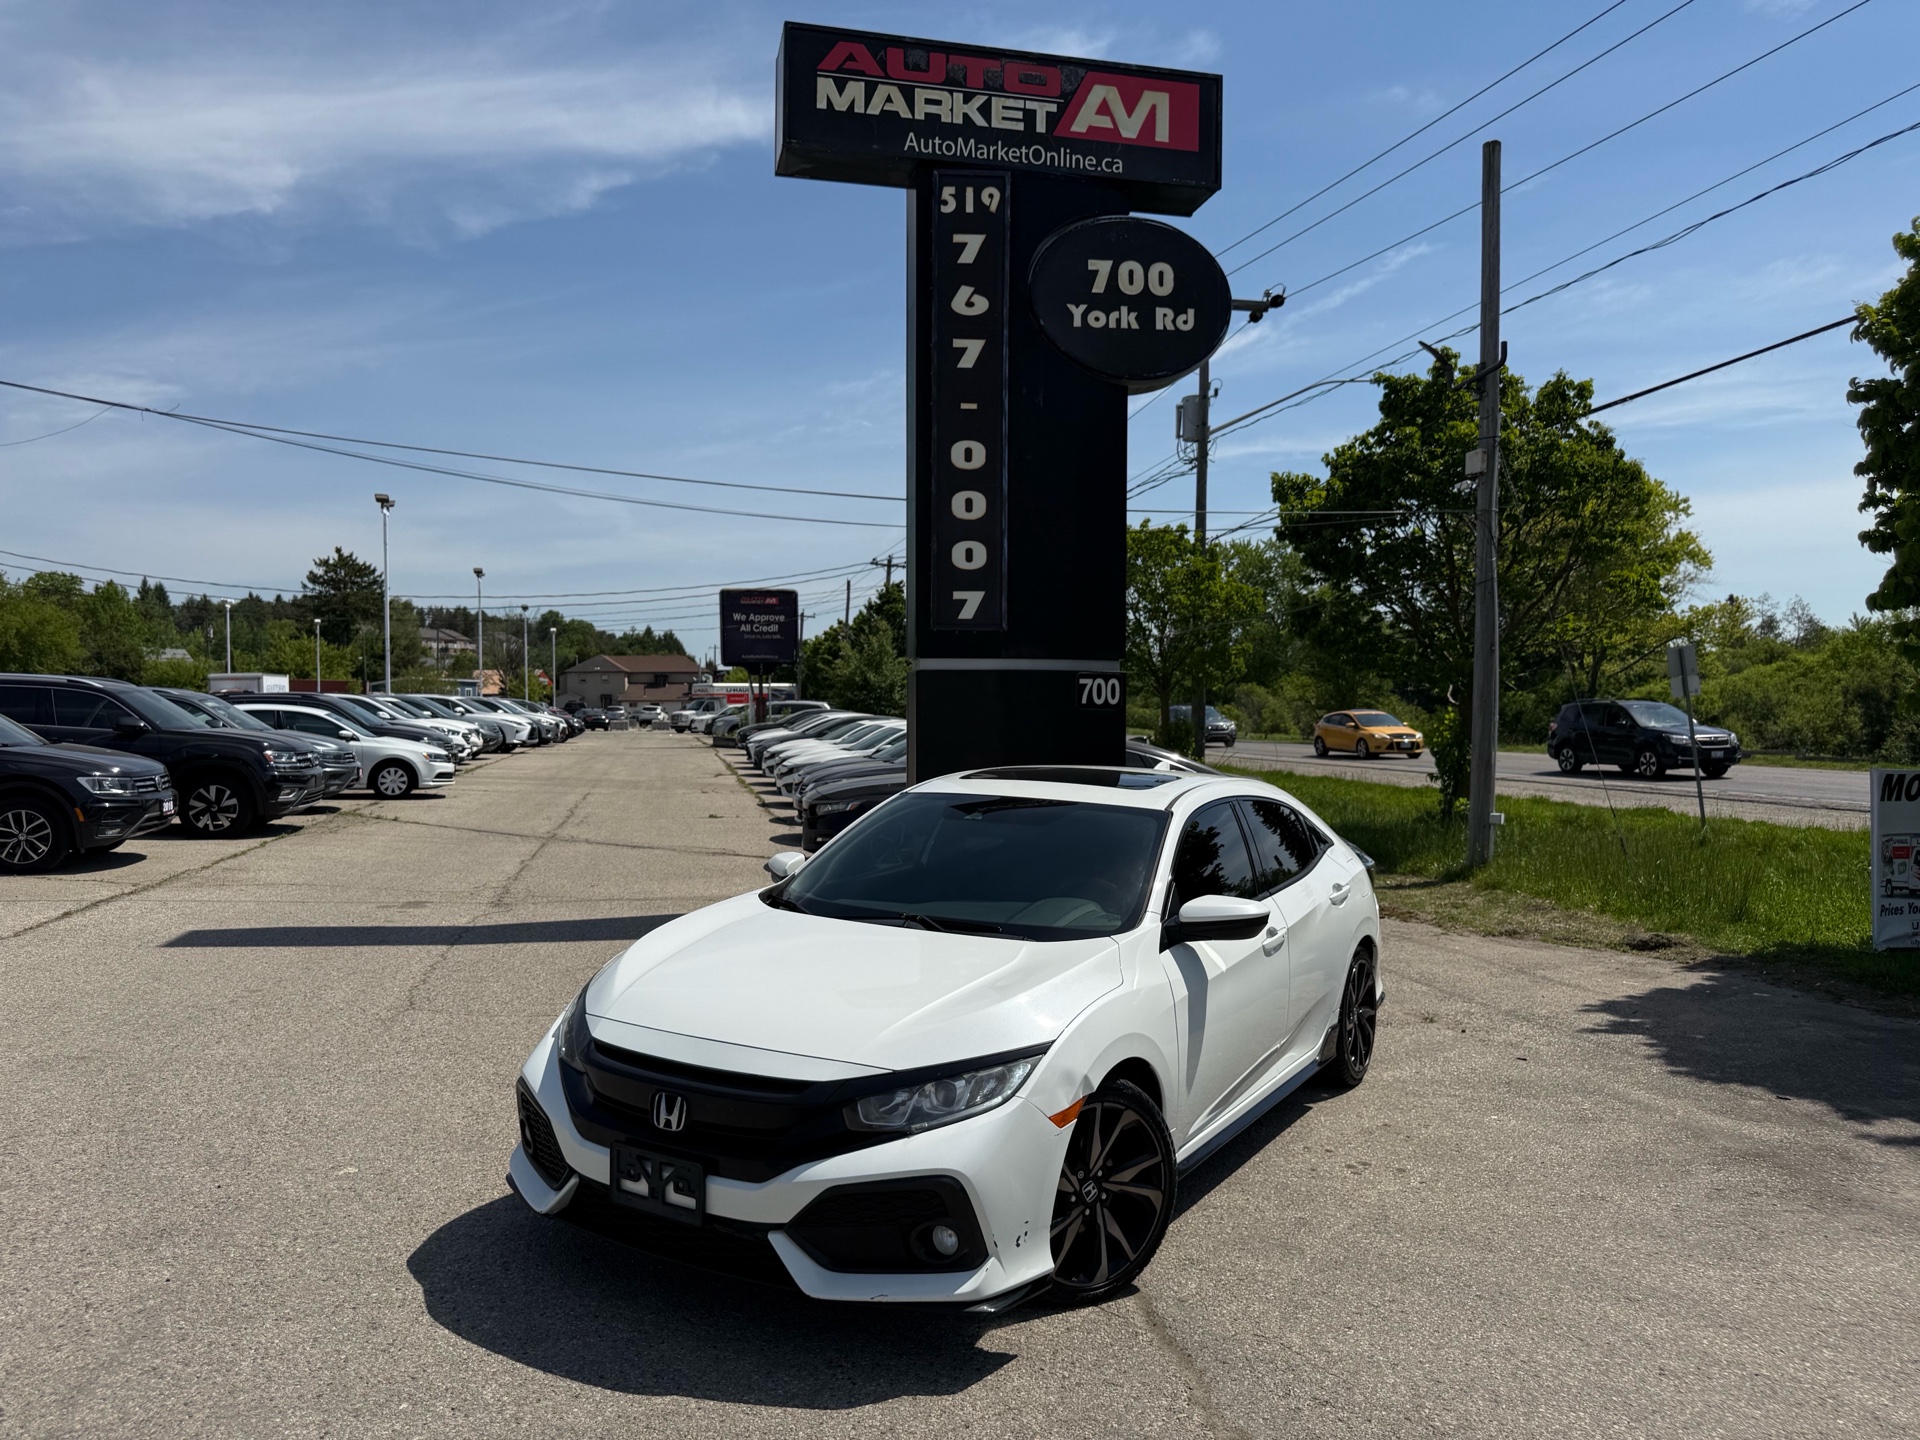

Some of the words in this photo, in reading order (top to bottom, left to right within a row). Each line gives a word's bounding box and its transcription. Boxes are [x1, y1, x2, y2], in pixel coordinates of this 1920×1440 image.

[816, 41, 1062, 96] AUTO
[816, 77, 1058, 134] MARKET
[1070, 84, 1170, 143] AM
[904, 132, 1123, 173] AutoMarketOnline.ca
[940, 186, 1000, 214] 519
[1087, 259, 1175, 297] 700
[1066, 303, 1140, 330] York
[1155, 306, 1195, 332] Rd
[732, 613, 747, 621] We
[749, 613, 785, 622] Approve
[740, 624, 751, 632] All
[752, 624, 779, 632] Credit
[1078, 678, 1121, 705] 700
[1880, 902, 1904, 917] Prices
[1908, 902, 1920, 915] Yo
